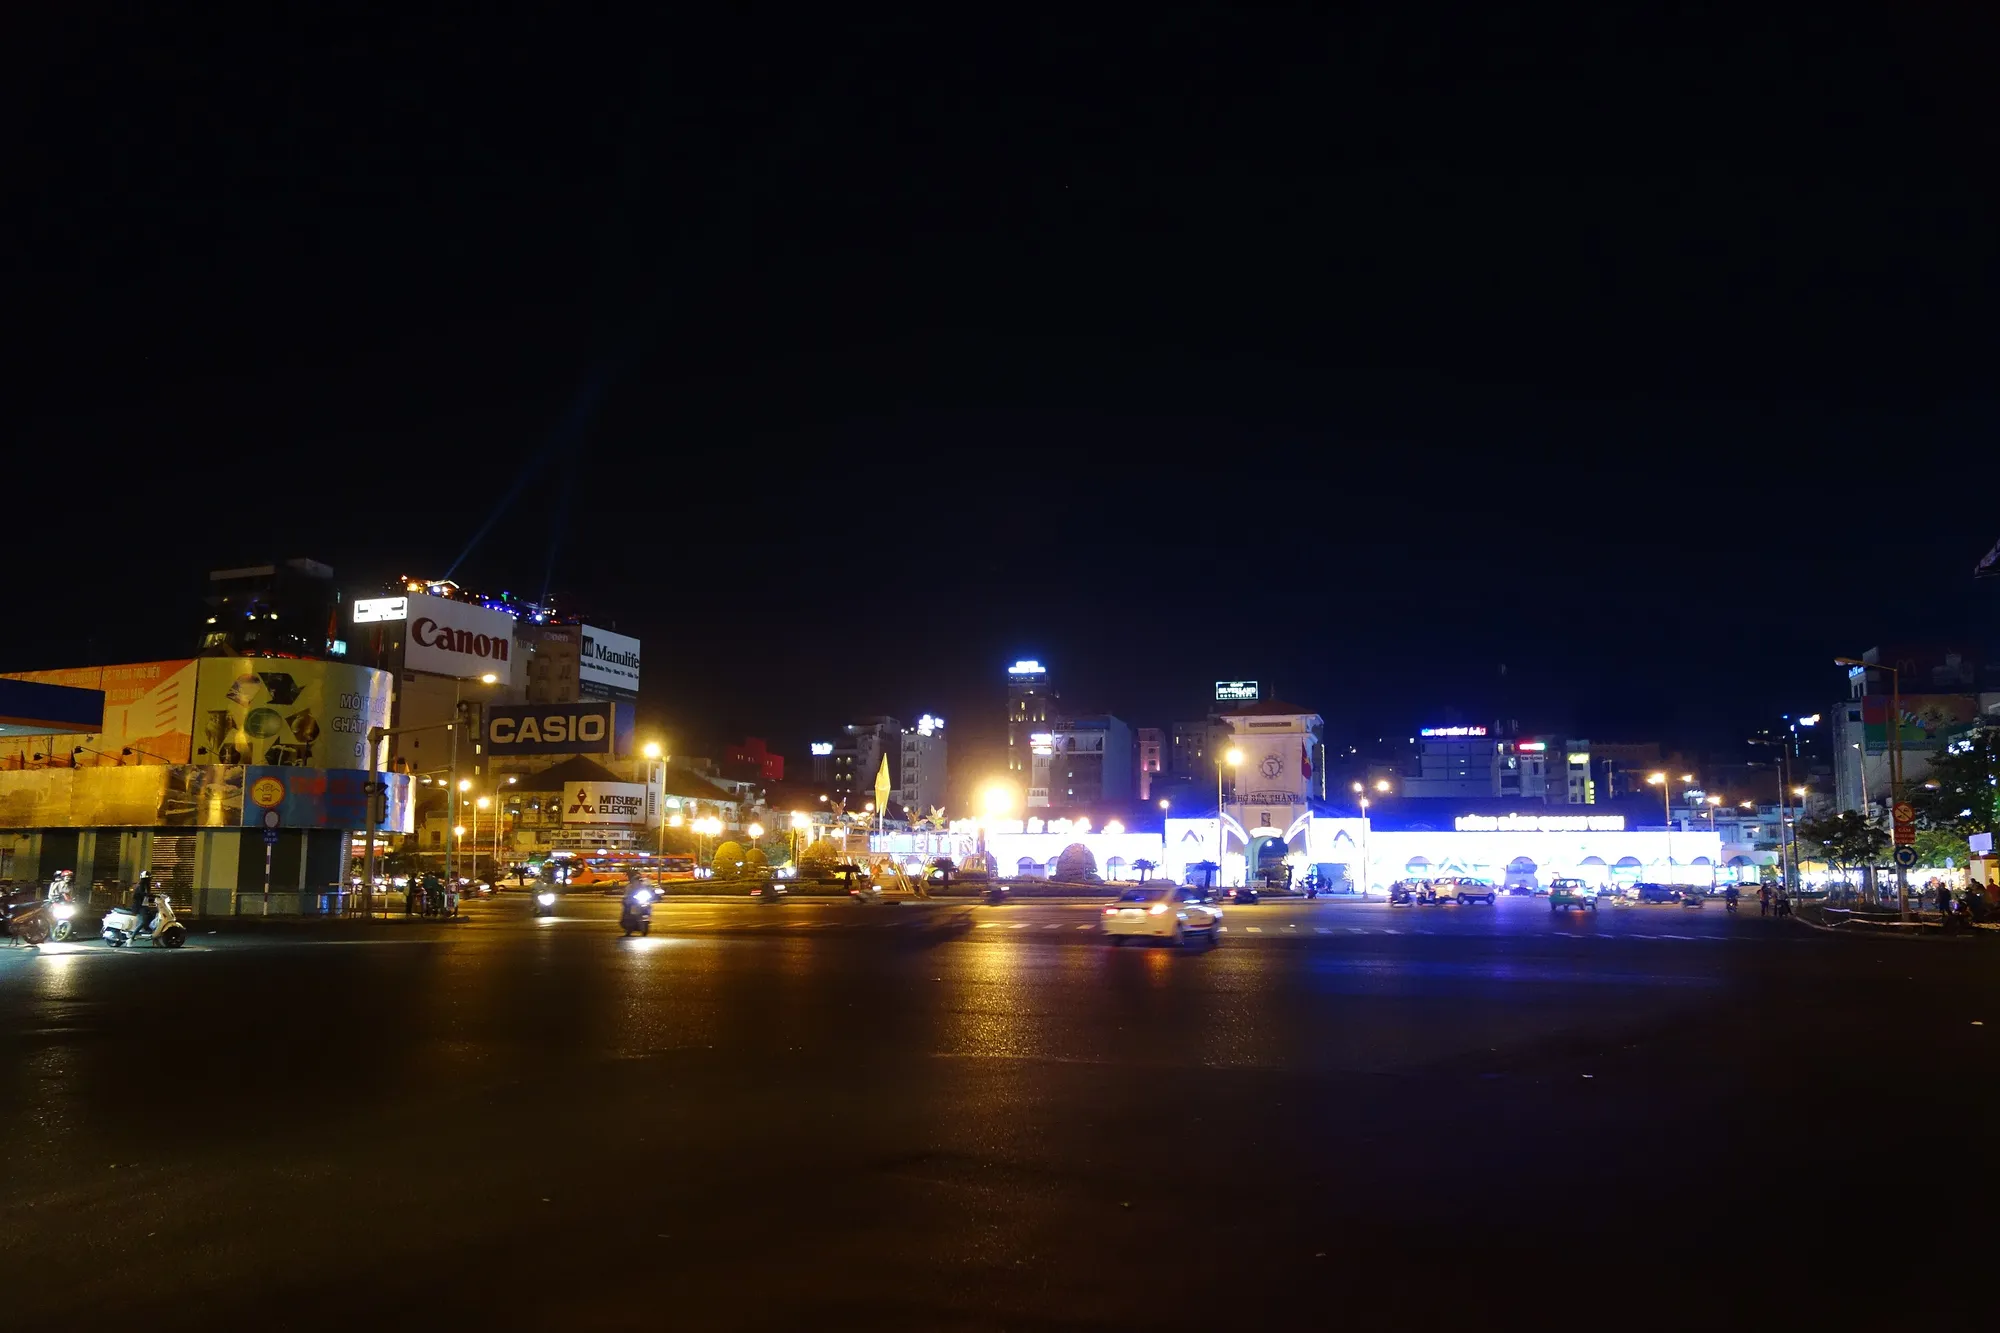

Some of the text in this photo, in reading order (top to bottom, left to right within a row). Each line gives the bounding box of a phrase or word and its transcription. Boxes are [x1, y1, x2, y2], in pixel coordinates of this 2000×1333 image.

[411, 617, 508, 661] Canon
[596, 644, 639, 668] Manulife
[340, 692, 364, 711] MÔI
[332, 714, 364, 734] CHẤT
[490, 714, 605, 744] CASIO
[599, 795, 642, 806] MITSUBISHI
[1270, 792, 1299, 802] THÀNH
[599, 805, 638, 815] ELECTRIC
